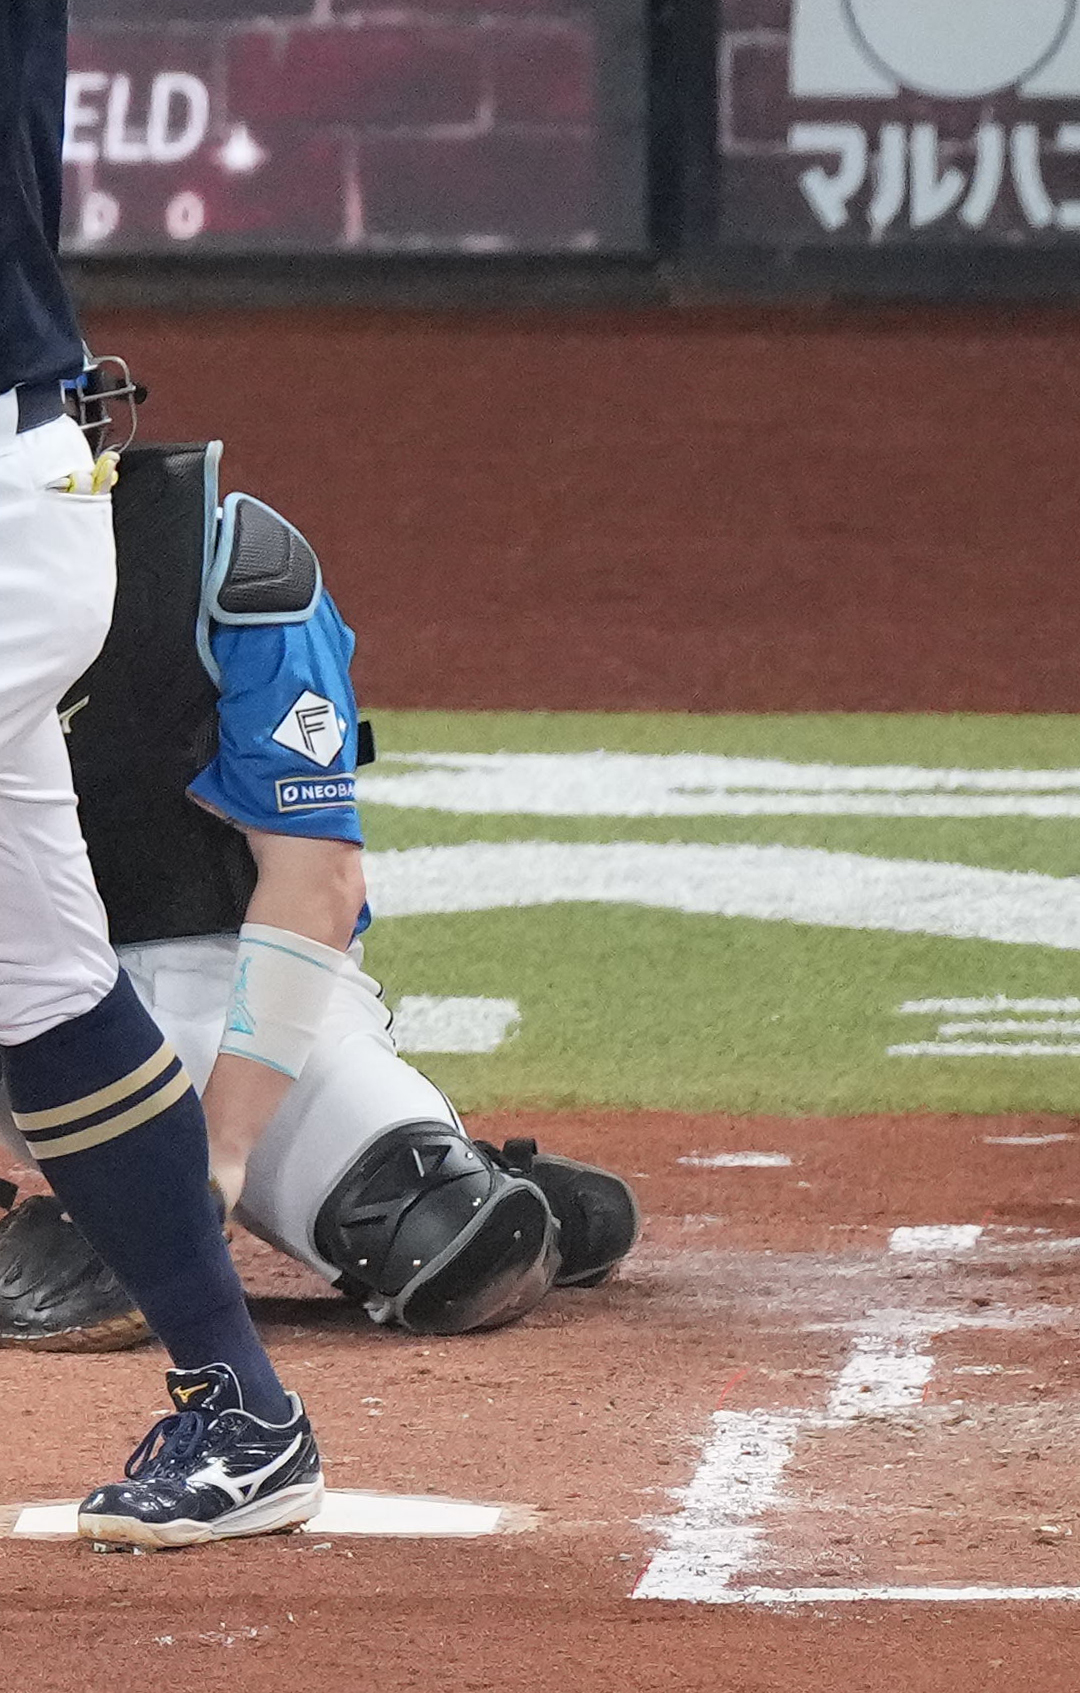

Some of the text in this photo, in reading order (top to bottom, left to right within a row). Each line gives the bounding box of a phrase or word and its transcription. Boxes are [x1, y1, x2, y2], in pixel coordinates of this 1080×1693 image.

[788, 122, 1080, 230] マルハ
[295, 705, 329, 755] F
